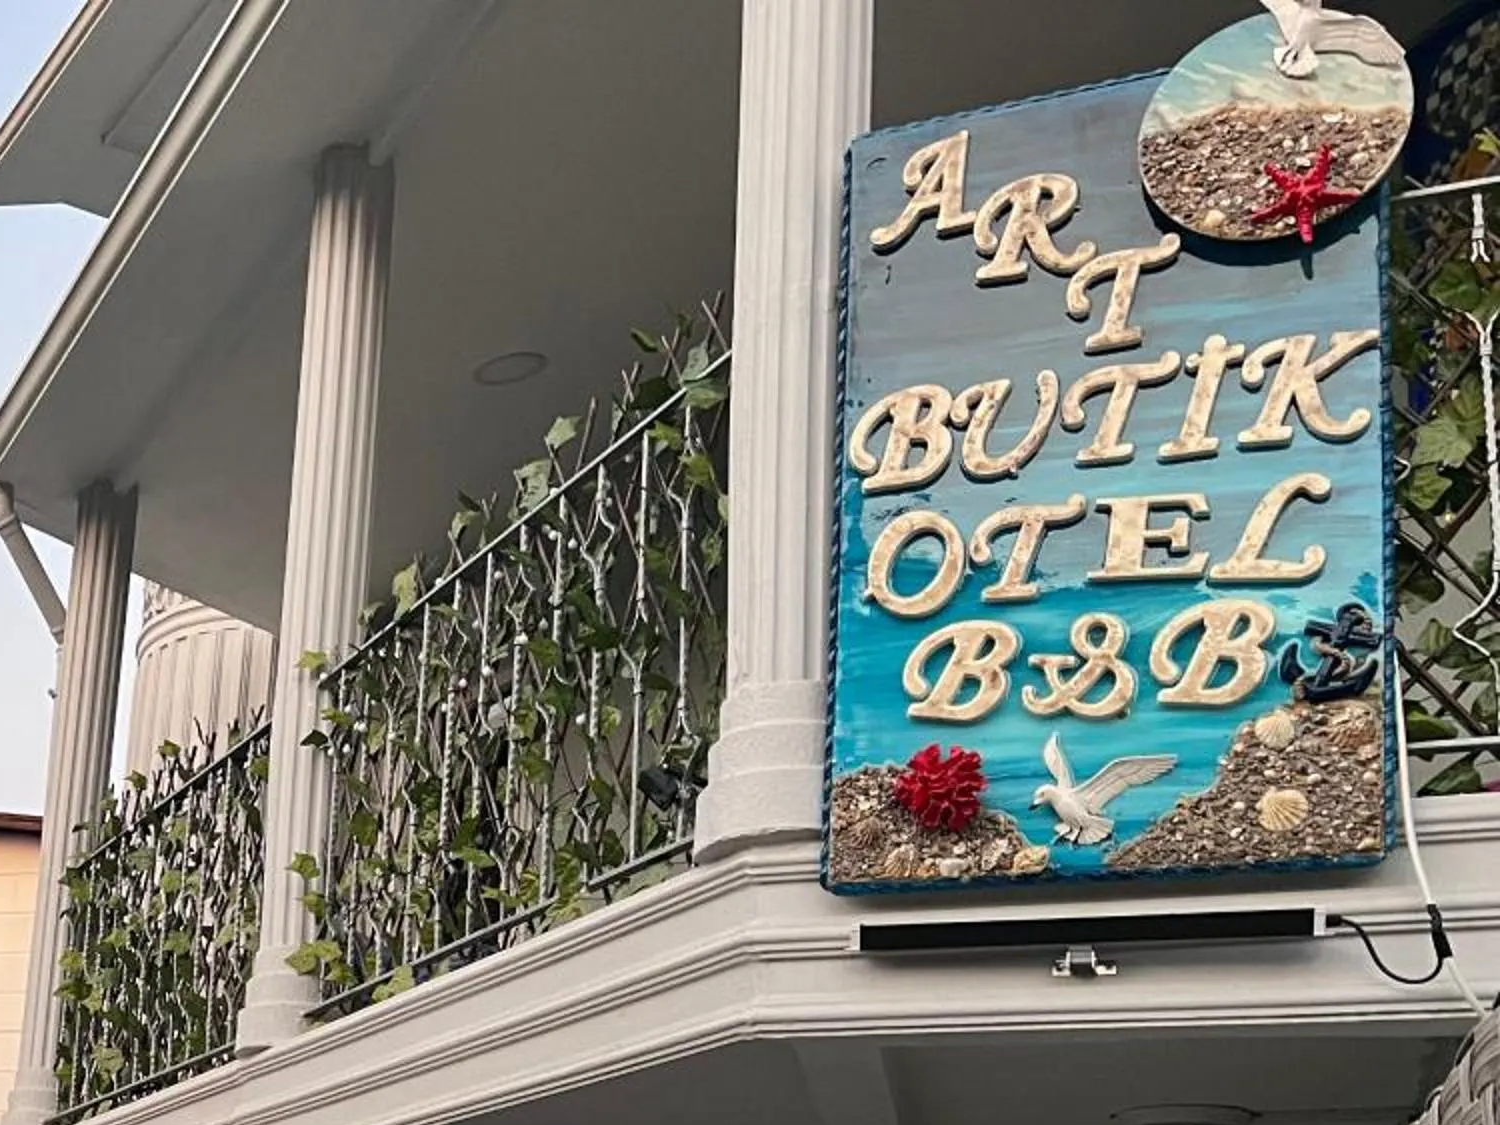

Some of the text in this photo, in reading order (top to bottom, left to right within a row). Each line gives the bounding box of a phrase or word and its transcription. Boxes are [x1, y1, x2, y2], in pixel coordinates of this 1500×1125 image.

[871, 130, 1180, 353] ART
[867, 474, 1332, 614] OTEL
[904, 601, 1278, 722] B&B
